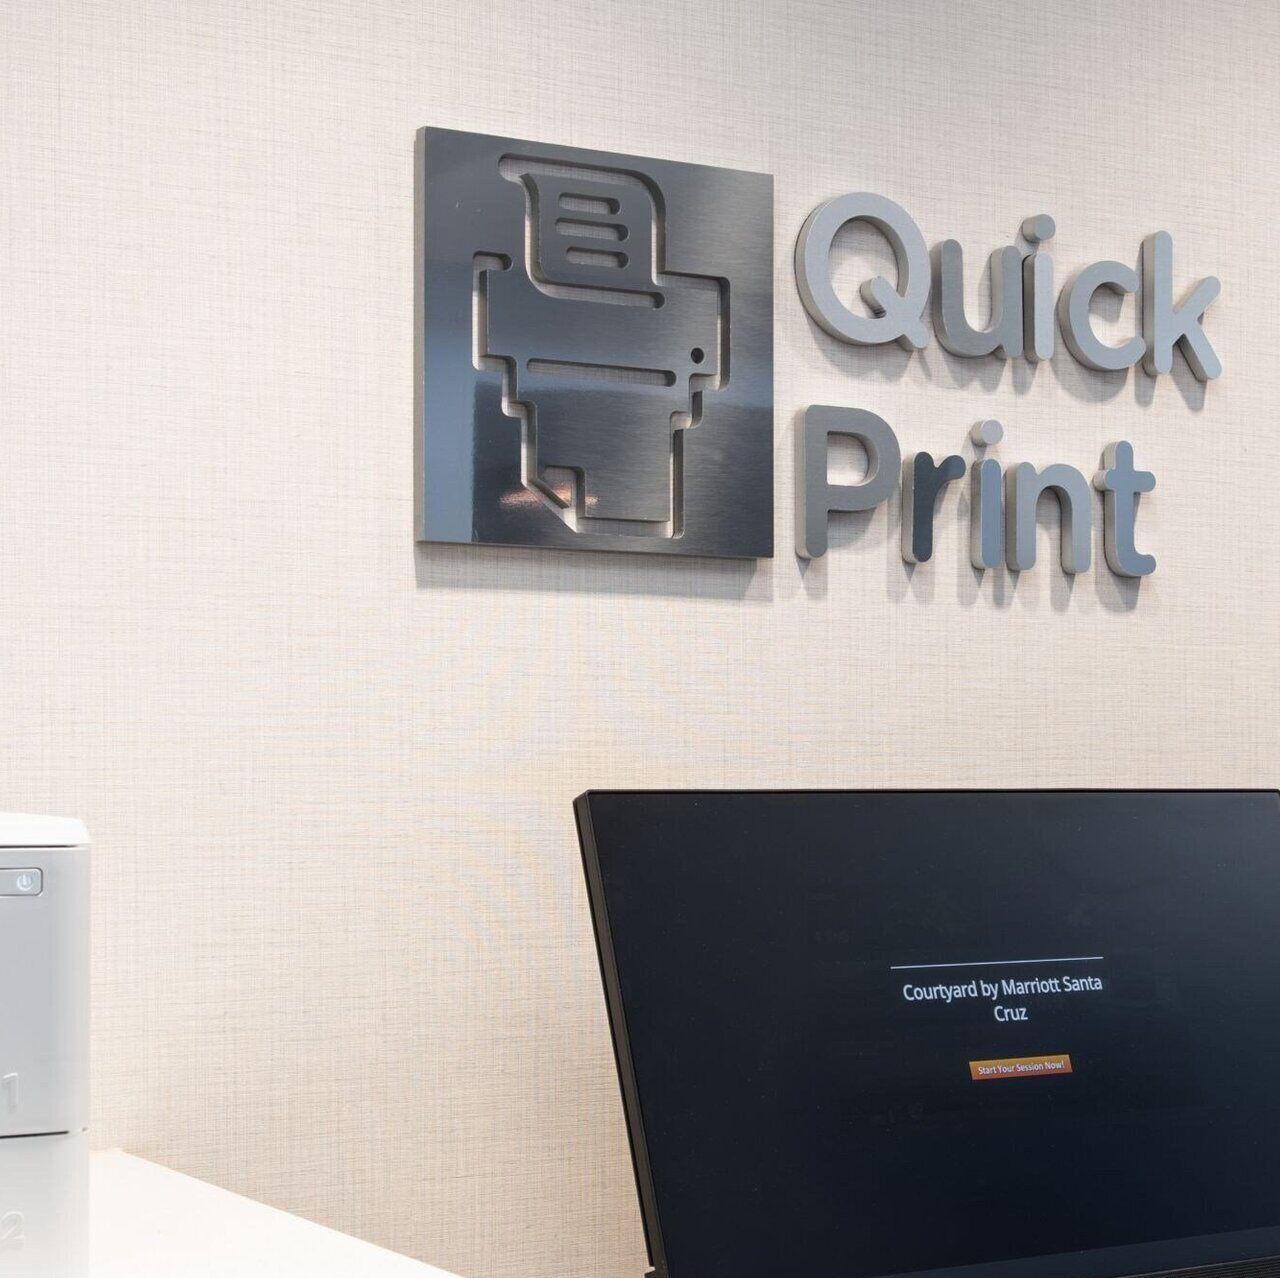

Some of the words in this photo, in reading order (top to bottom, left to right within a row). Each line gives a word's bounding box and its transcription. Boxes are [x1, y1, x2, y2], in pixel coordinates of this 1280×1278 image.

[795, 191, 1222, 382] Quick
[794, 403, 1157, 578] Print
[903, 980, 977, 1003] Courtyard
[980, 980, 999, 1000] by
[1001, 977, 1061, 996] Marriott
[1062, 975, 1103, 992] Santa
[993, 1005, 1028, 1022] Cruz
[978, 1066, 997, 1075] Start
[997, 1065, 1015, 1074] Your
[1016, 1063, 1044, 1073] Session
[1044, 1061, 1065, 1070] Now!
[2, 1071, 20, 1114] 1
[0, 1210, 25, 1241] 2
